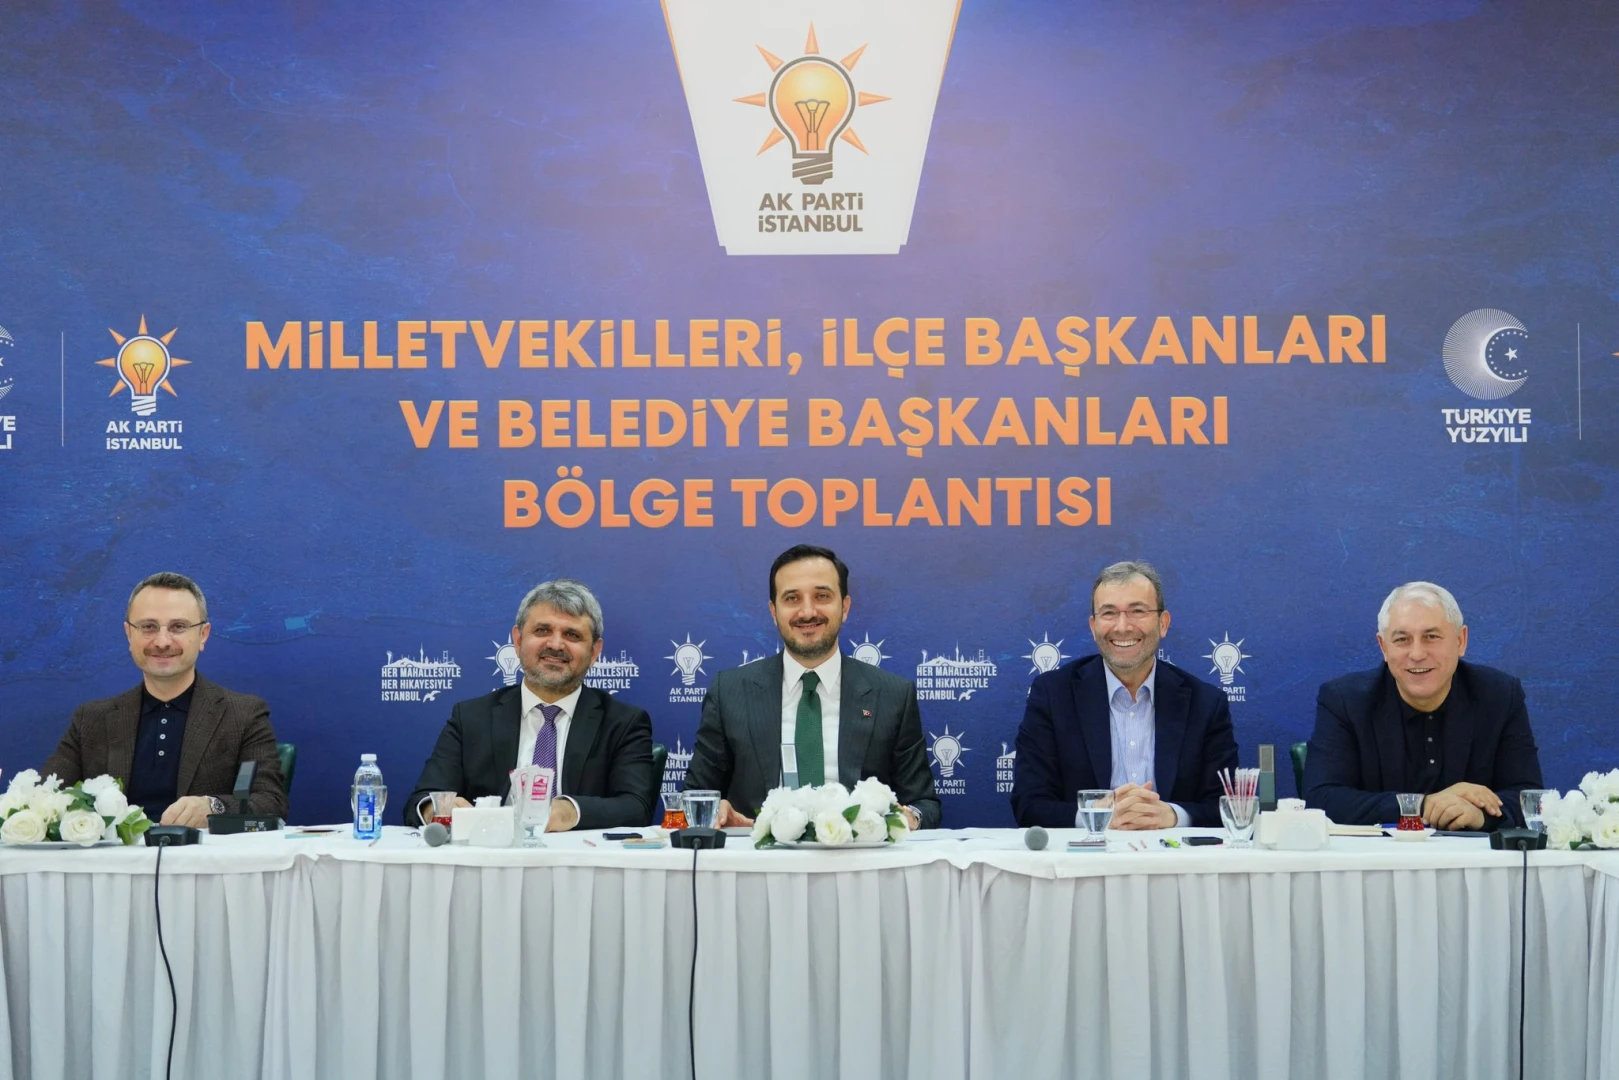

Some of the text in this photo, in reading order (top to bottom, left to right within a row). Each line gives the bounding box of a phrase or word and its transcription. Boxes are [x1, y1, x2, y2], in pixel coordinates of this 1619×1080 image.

[758, 192, 864, 211] AK PARTİ
[758, 214, 864, 233] İSTANBUL
[245, 314, 1387, 379] MİLLETVEKİLLERİ, İLÇE BAŞKANLARI
[106, 420, 183, 433] AK PARTİ
[398, 396, 1229, 458] VE BELEDİYE BAŞKANLARI
[106, 437, 183, 450] İSTANBUL
[503, 465, 1112, 529] BÖLGE TOPLANTISI
[381, 667, 461, 678] HER MAHALLESİYLE
[585, 667, 640, 677] AHALLESİYLE
[916, 666, 997, 677] HER MAHALLESİYLE
[381, 679, 453, 690] HER HİKAYESİYLE
[583, 678, 631, 689] İKAYESİYLE
[916, 677, 989, 688] HER HİKAYESİYLE
[381, 691, 421, 701] İSTANBUL
[669, 687, 682, 695] AK
[916, 690, 957, 700] İSTANBUL
[669, 695, 704, 703] İSTANBU
[996, 758, 1014, 769] HER
[996, 770, 1014, 781] HER
[942, 779, 966, 788] PARTİ
